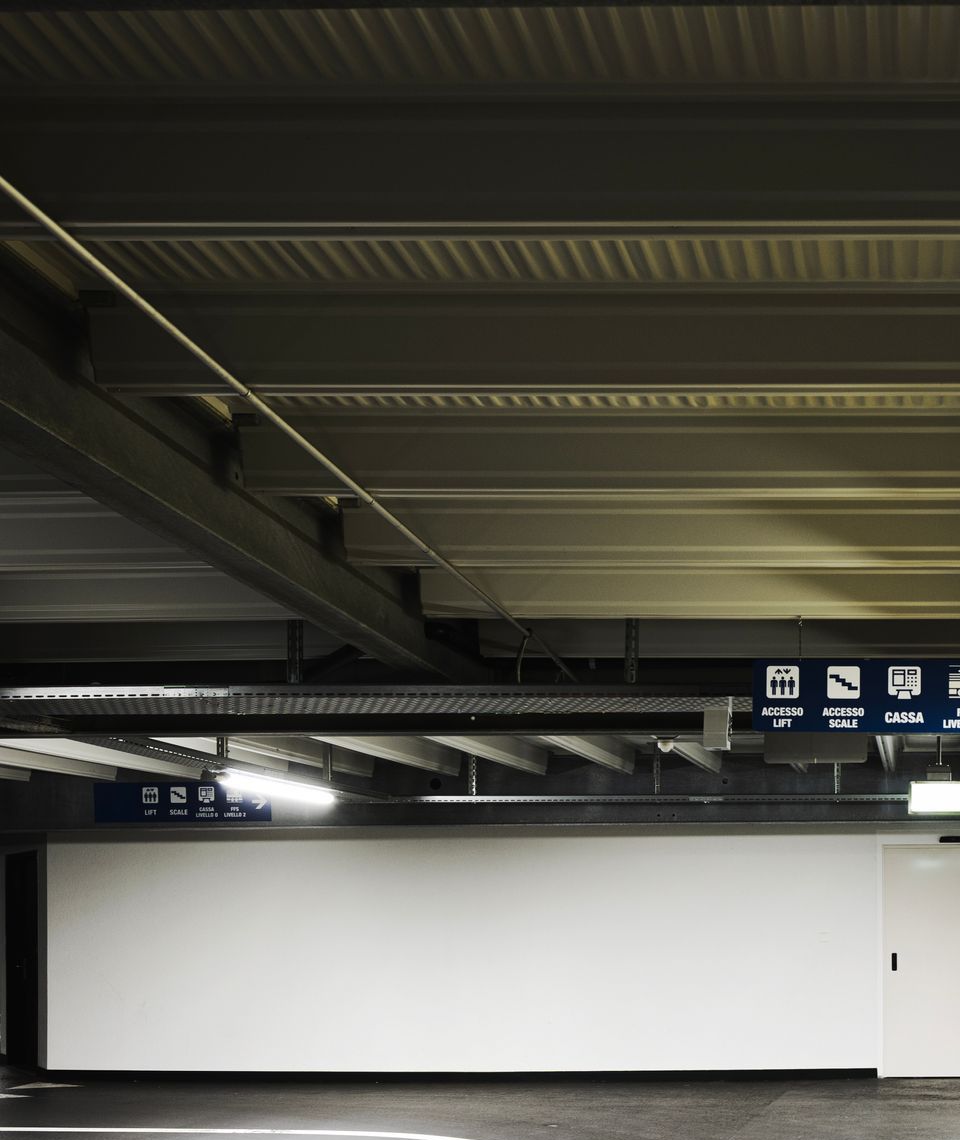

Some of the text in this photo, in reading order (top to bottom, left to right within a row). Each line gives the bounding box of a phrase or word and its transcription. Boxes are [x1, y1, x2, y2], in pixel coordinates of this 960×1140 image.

[761, 707, 804, 717] ACCESSO
[822, 707, 865, 717] ACCESSO
[884, 711, 925, 724] CASSA
[773, 718, 792, 728] LIFT
[828, 718, 858, 728] SCALE
